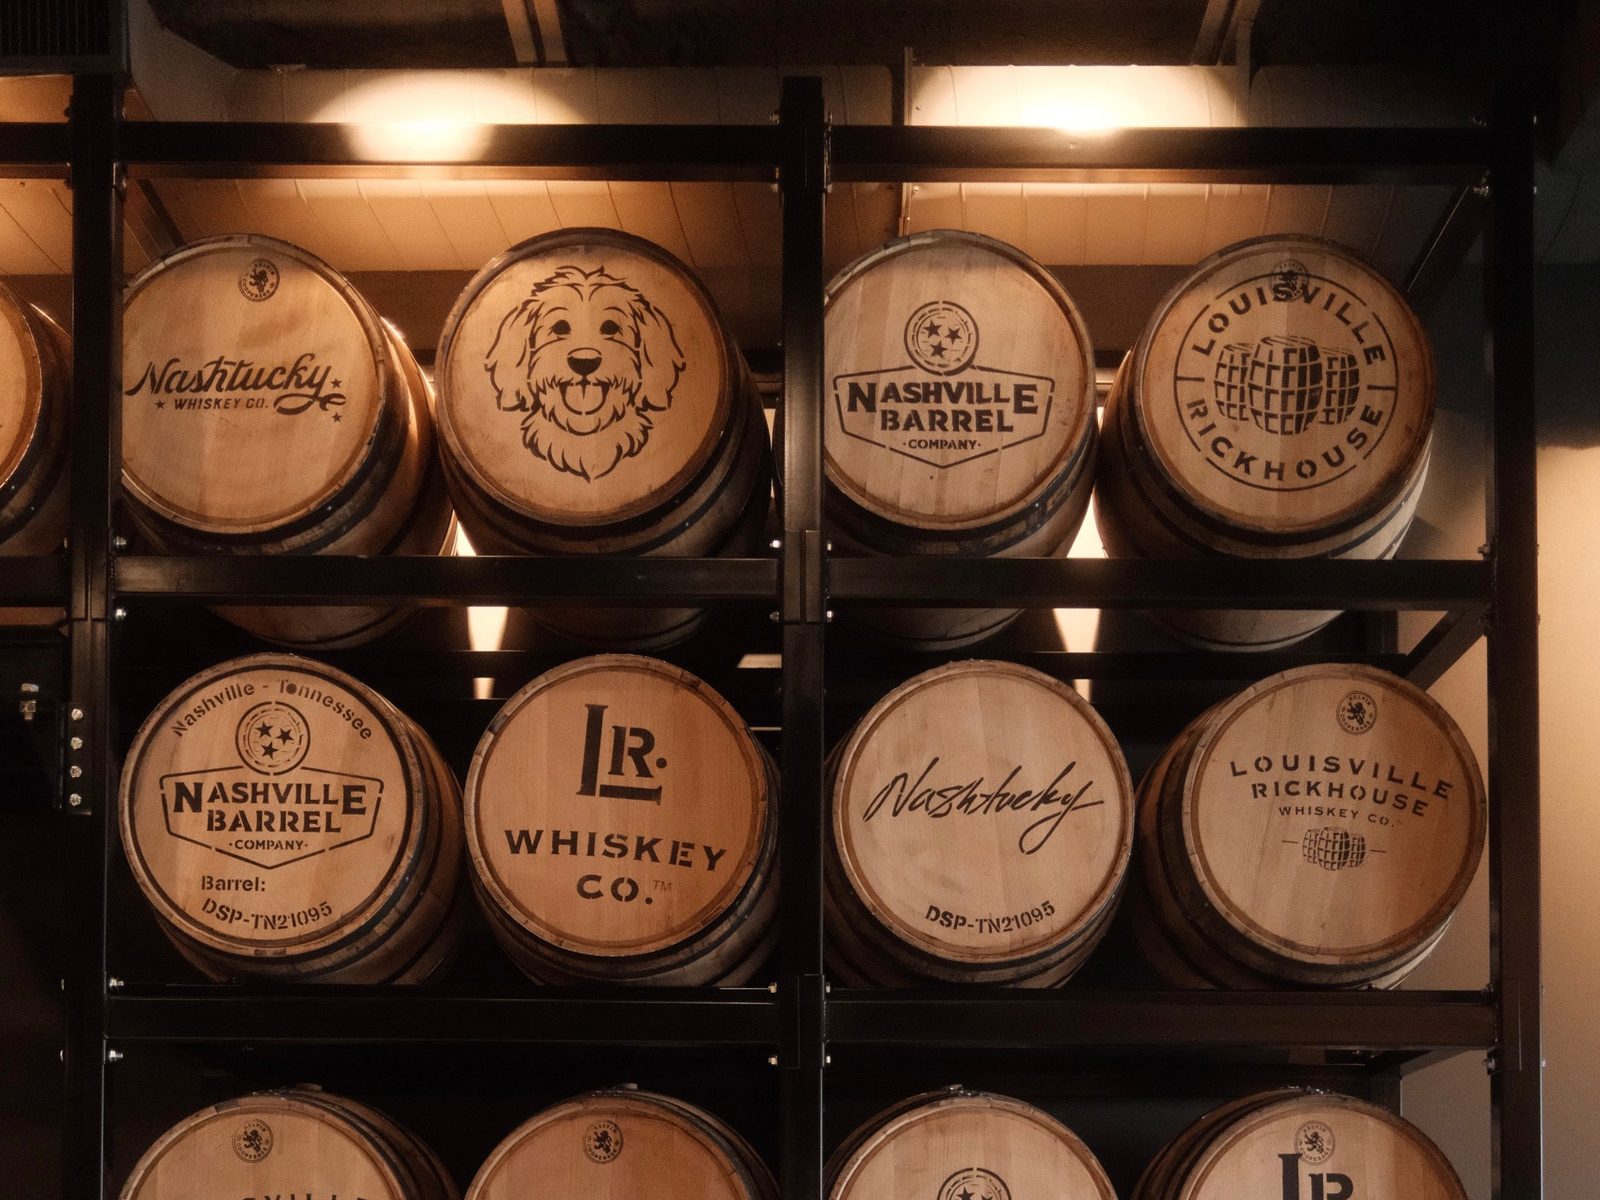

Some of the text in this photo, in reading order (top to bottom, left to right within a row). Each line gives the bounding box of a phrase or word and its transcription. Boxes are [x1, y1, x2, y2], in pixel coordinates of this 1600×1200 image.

[1192, 284, 1386, 365] LOUISVILLE
[125, 353, 346, 415] Nashtucky
[847, 381, 1038, 414] NASHVILLE
[174, 398, 268, 410] WHISKEY CO.
[881, 409, 1014, 432] BARREL
[908, 439, 977, 450] COMPANY
[1186, 399, 1383, 481] RICKHOUSE
[171, 683, 255, 737] Nashville
[279, 679, 372, 740] Tnnessee
[1230, 755, 1453, 800] LOUISVILLE
[173, 782, 367, 815] NASHVILLE
[863, 757, 1104, 854] Nashtucky
[1251, 781, 1429, 816] RICKHOUSE
[207, 810, 341, 833] BARREL
[1279, 806, 1395, 827] WHISKEY CO.
[235, 839, 304, 850] COMPANY
[504, 829, 727, 871] WHISKEY
[201, 875, 265, 891] Barrel:
[576, 874, 653, 904] CO.
[202, 898, 332, 929] DSP-TN21095
[925, 901, 1055, 933] DSP-TN21095
